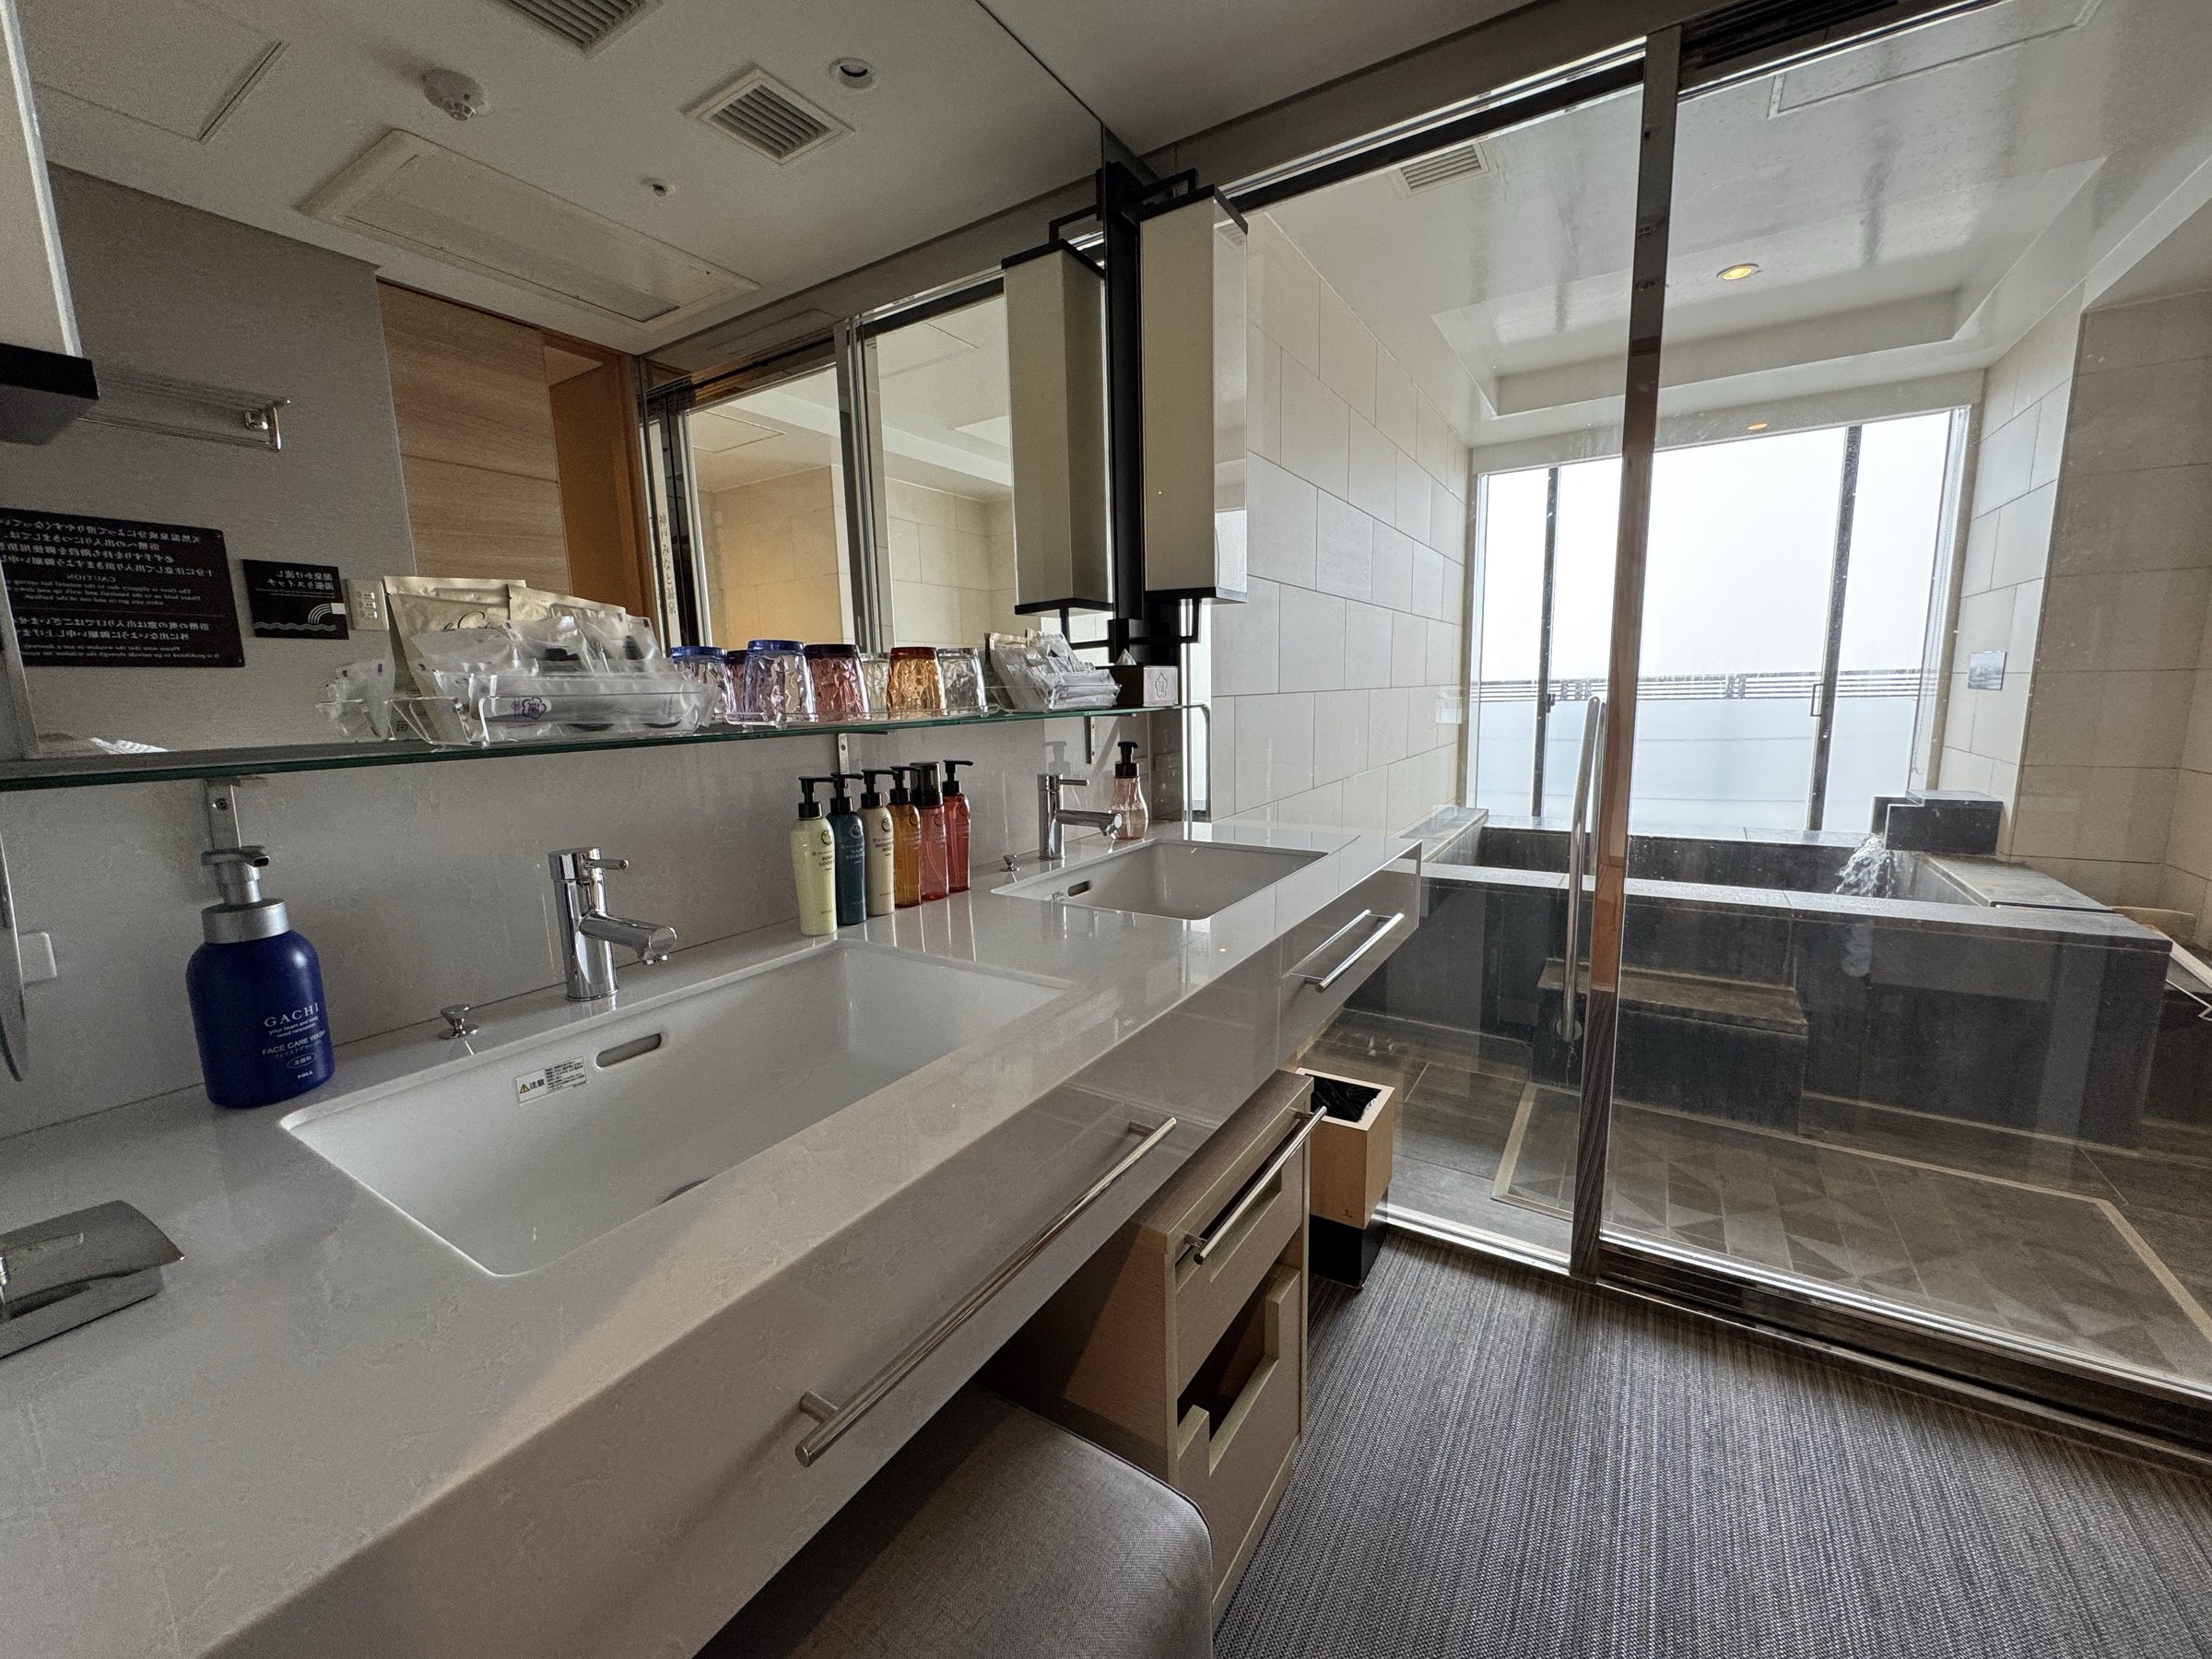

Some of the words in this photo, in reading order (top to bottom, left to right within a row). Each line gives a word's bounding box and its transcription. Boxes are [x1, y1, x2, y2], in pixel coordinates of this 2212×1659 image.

[264, 1003, 319, 1027] GACHI
[262, 1044, 286, 1055] FACE
[287, 1037, 309, 1049] CARE
[309, 1029, 326, 1041] WASH
[529, 1078, 545, 1089] 注意
